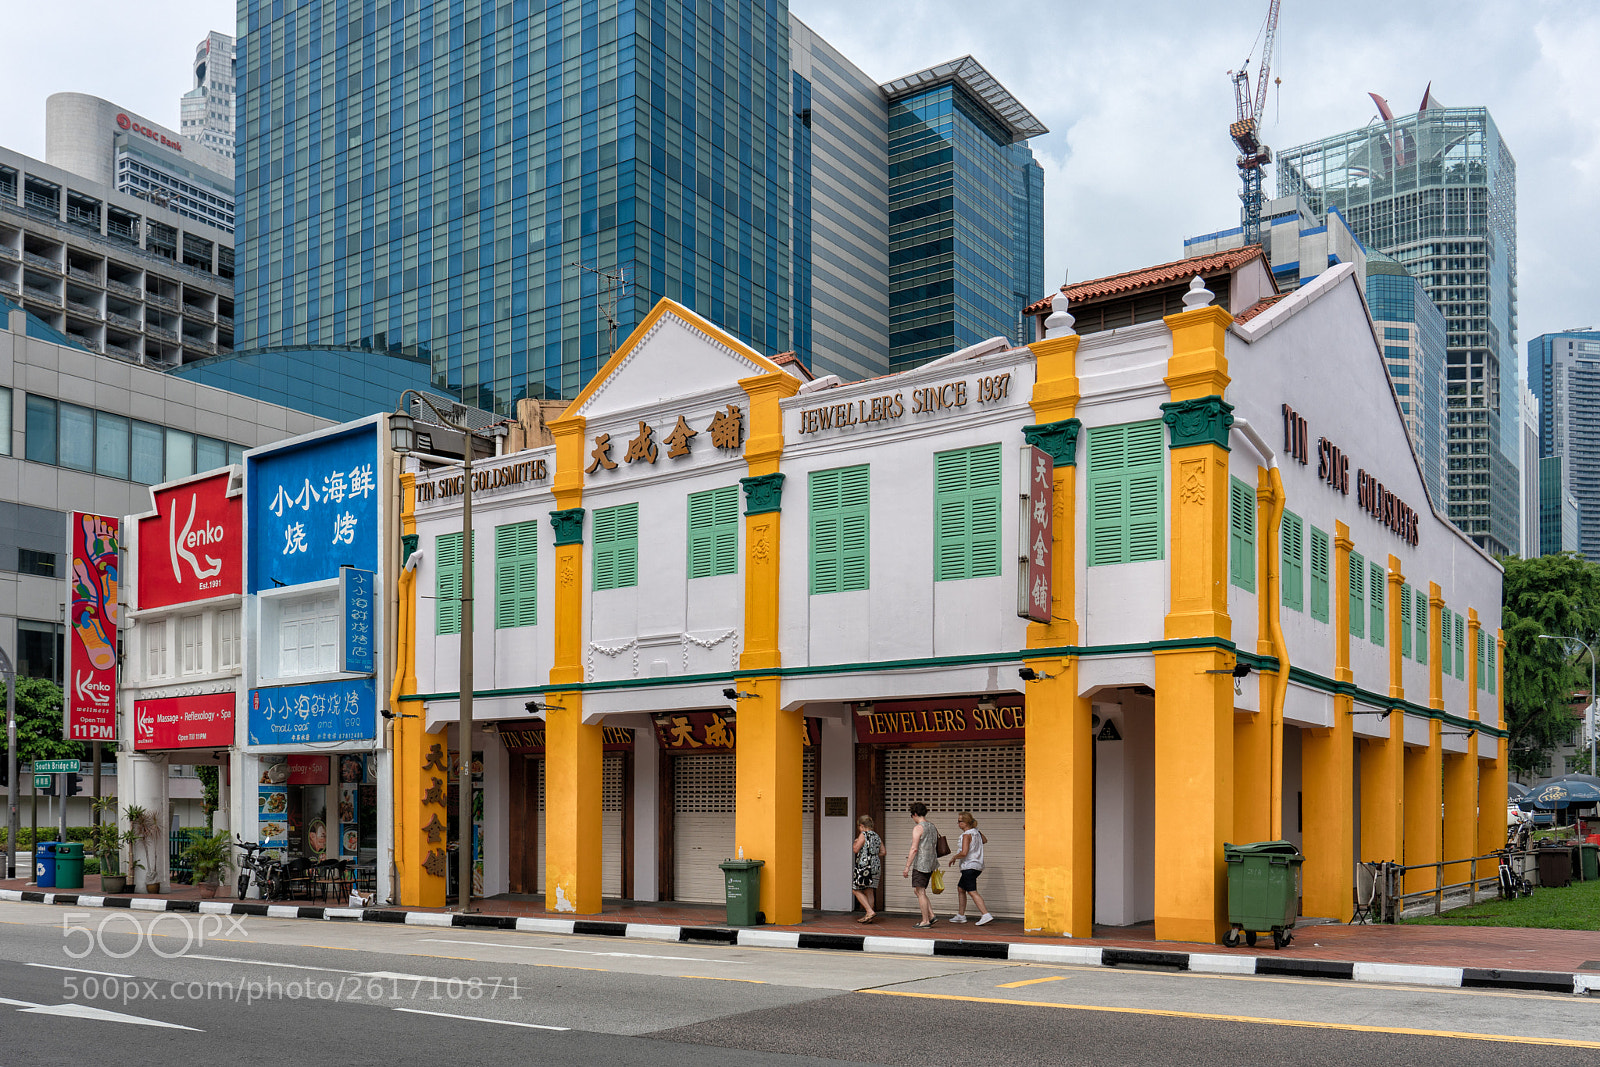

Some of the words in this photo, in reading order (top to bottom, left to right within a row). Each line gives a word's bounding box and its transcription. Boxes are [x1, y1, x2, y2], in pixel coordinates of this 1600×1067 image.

[132, 122, 159, 141] OCBC
[161, 135, 182, 152] Bank
[798, 393, 904, 434] JEWELLERS
[911, 380, 967, 414] SINCE
[977, 373, 1011, 402] 1937
[269, 463, 376, 517] 小小海鲜
[416, 481, 435, 502] TIN
[438, 475, 464, 498] SING
[470, 459, 547, 492] GOLDSMITHS
[1282, 403, 1308, 465] TIN
[1318, 436, 1349, 495] SING
[1357, 468, 1419, 547] GOLDSMITHS
[170, 493, 224, 584] Kenko
[76, 669, 111, 703] Kenko
[157, 714, 179, 724] Massage
[184, 710, 215, 722] Reflexology
[220, 708, 232, 720] Spa
[263, 690, 359, 720] 小小海鲜烧烤
[137, 706, 154, 735] Kenko
[868, 709, 966, 735] JEWELLERS
[972, 706, 1025, 731] SINCE
[177, 734, 188, 742] Open
[499, 732, 523, 748] TIN
[36, 762, 51, 770] South
[51, 762, 69, 771] Bridge
[71, 761, 78, 769] Rd
[1542, 791, 1568, 801] Tiger
